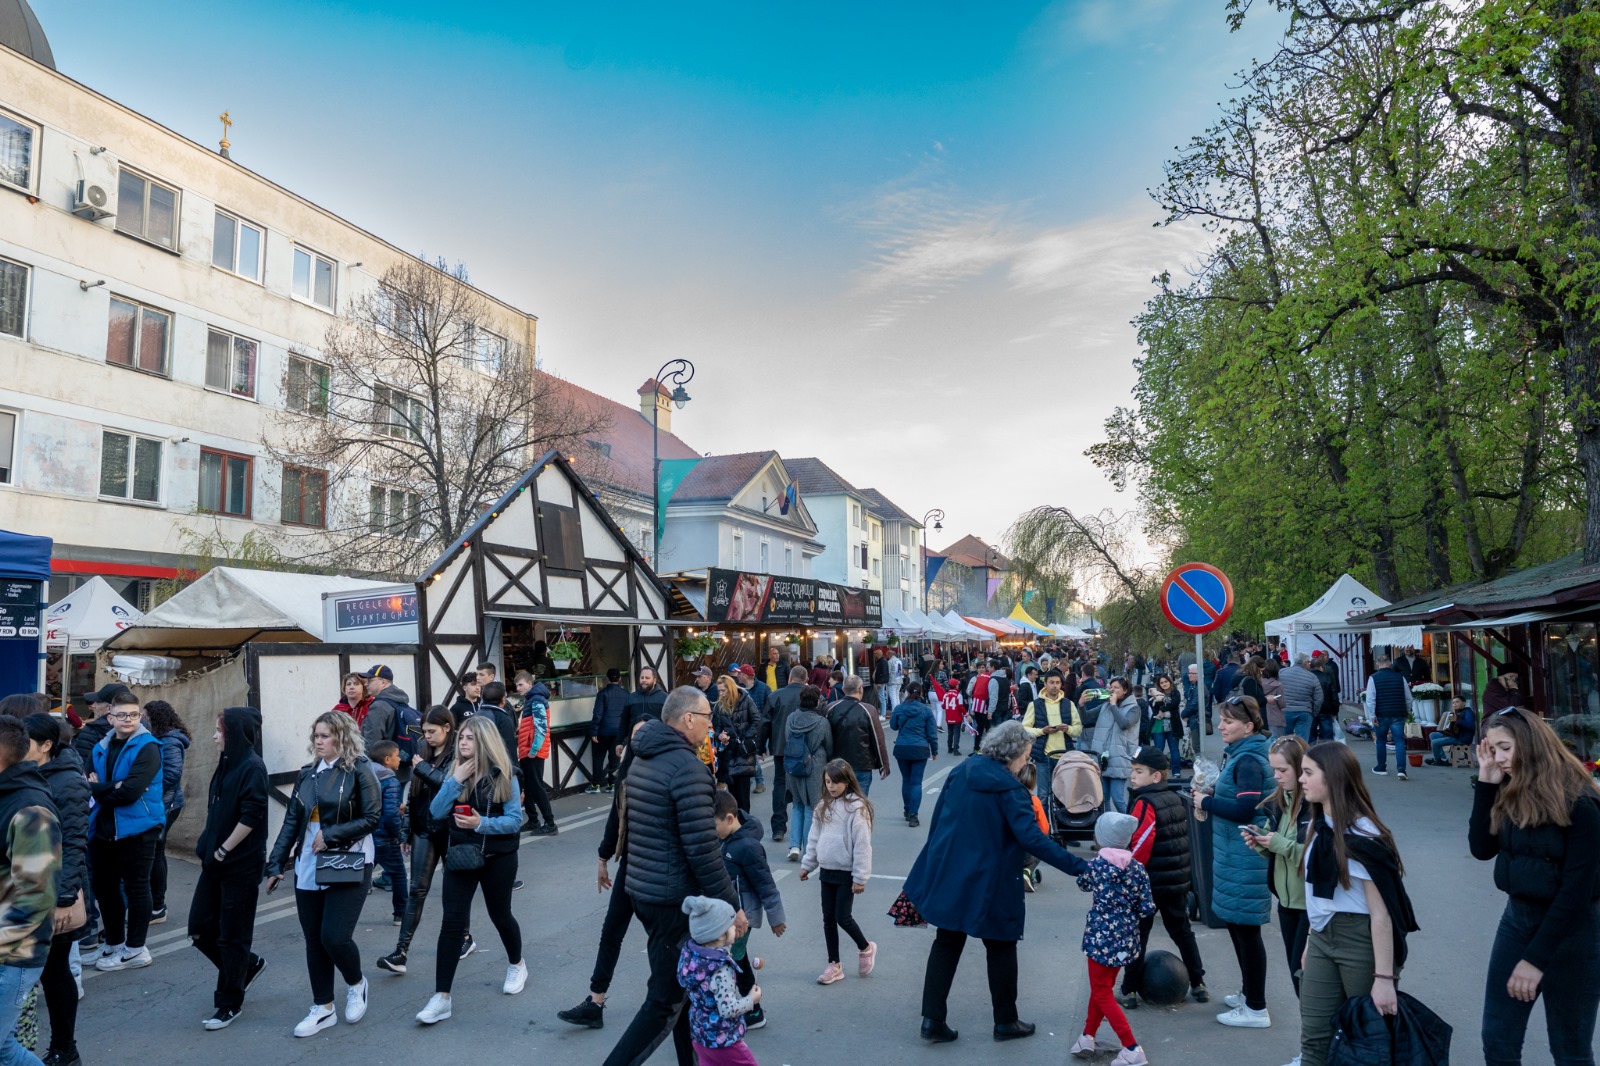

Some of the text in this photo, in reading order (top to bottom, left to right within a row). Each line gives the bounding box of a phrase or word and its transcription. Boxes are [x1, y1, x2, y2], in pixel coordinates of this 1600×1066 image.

[346, 600, 382, 612] REGELE
[946, 697, 956, 710] 14
[316, 855, 364, 870] Karl
